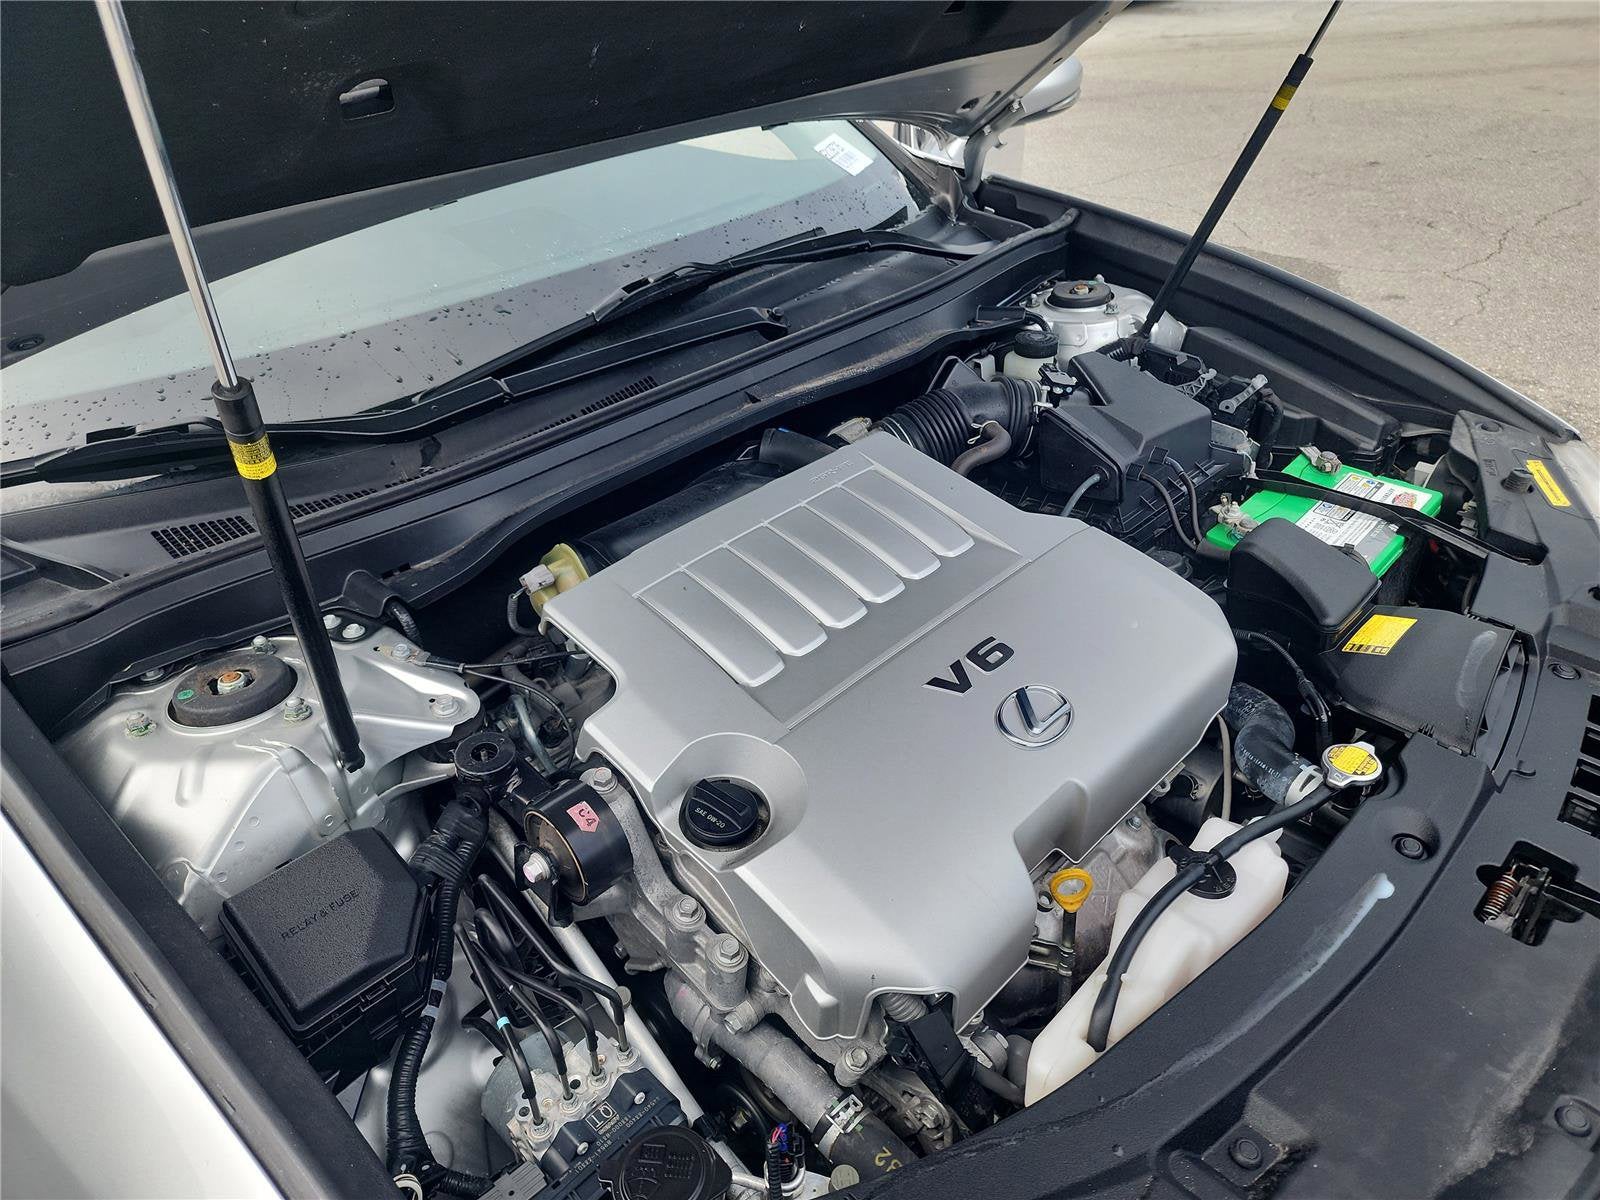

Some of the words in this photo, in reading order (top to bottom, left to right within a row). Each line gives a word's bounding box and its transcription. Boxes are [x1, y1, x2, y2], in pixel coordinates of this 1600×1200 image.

[922, 635, 1015, 696] V6
[694, 807, 708, 817] SAE
[707, 813, 726, 829] 0W-20
[281, 914, 318, 942] RELAY
[319, 908, 329, 918] &
[329, 889, 360, 911] FUSE
